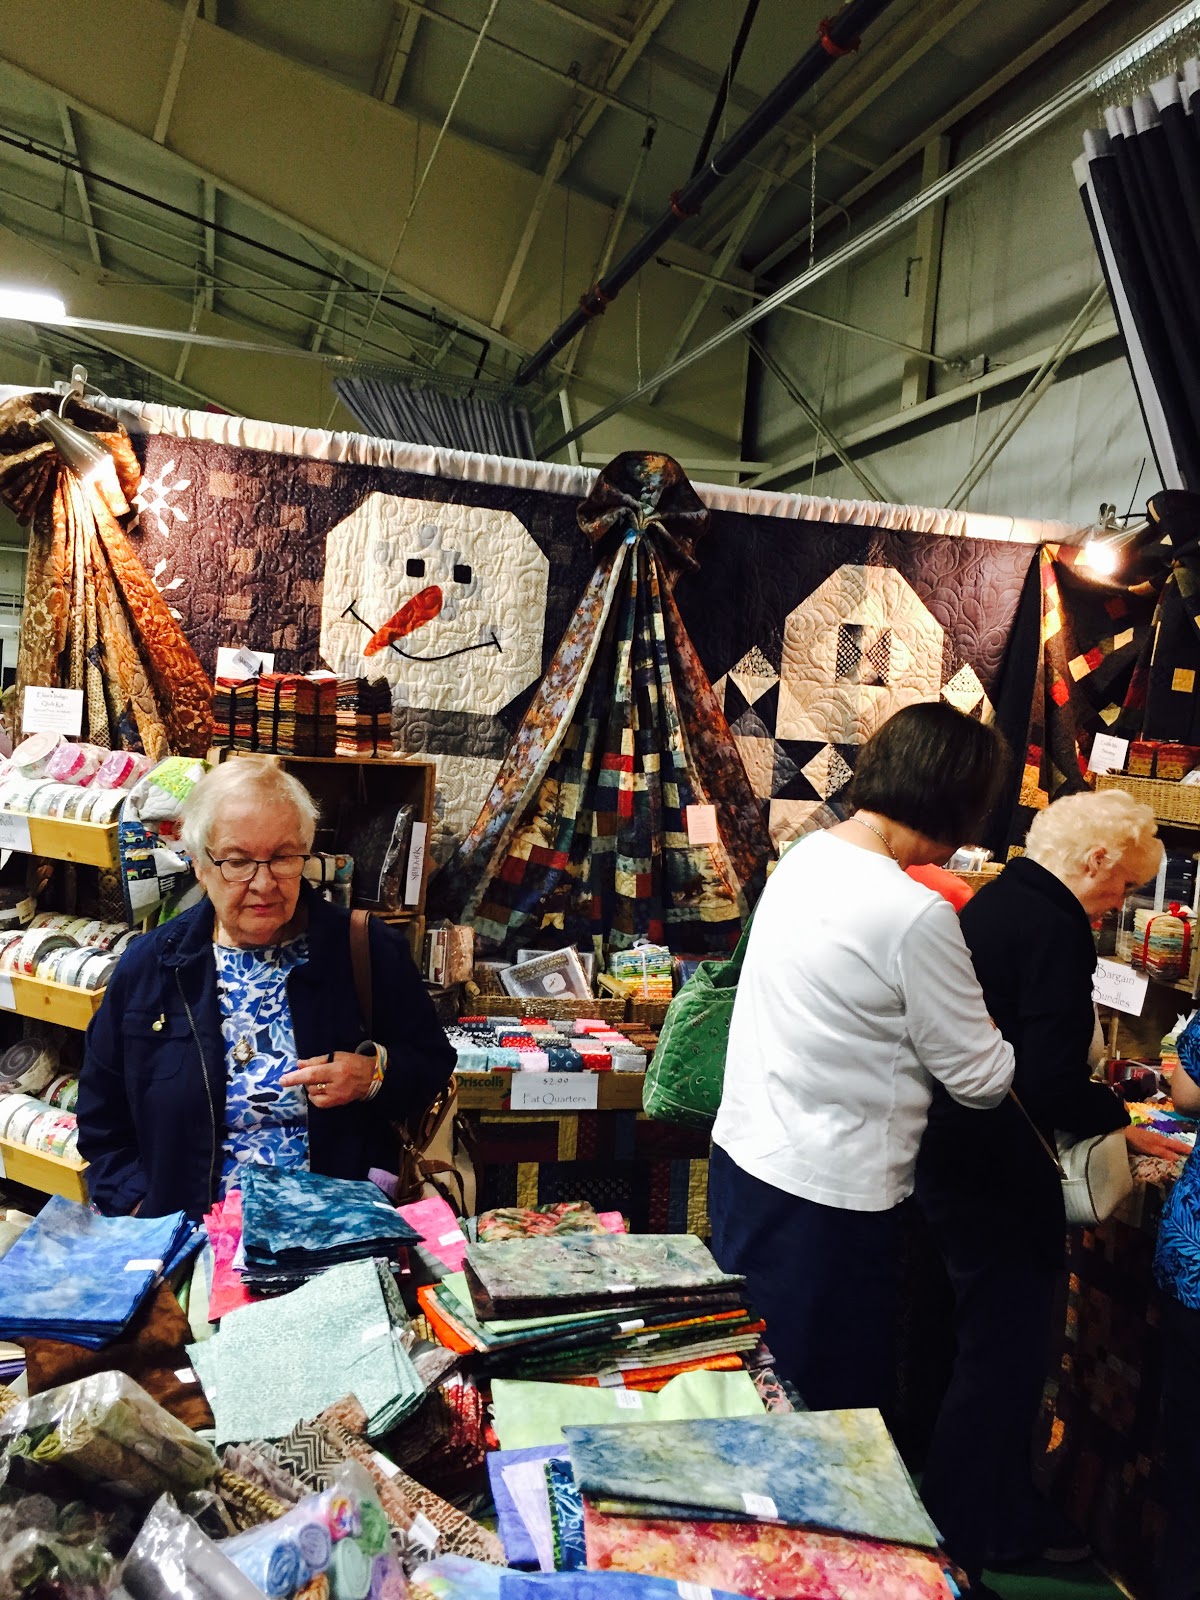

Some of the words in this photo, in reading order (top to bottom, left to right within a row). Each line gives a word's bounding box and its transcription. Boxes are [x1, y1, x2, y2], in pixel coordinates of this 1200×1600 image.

[411, 846, 423, 880] Specials
[1096, 963, 1135, 985] Bargain
[1091, 985, 1131, 1007] Bundles
[456, 1075, 504, 1087] Driscoll's
[543, 1077, 569, 1086] $2.99
[523, 1092, 540, 1104] Fat
[542, 1092, 587, 1105] Quarters
